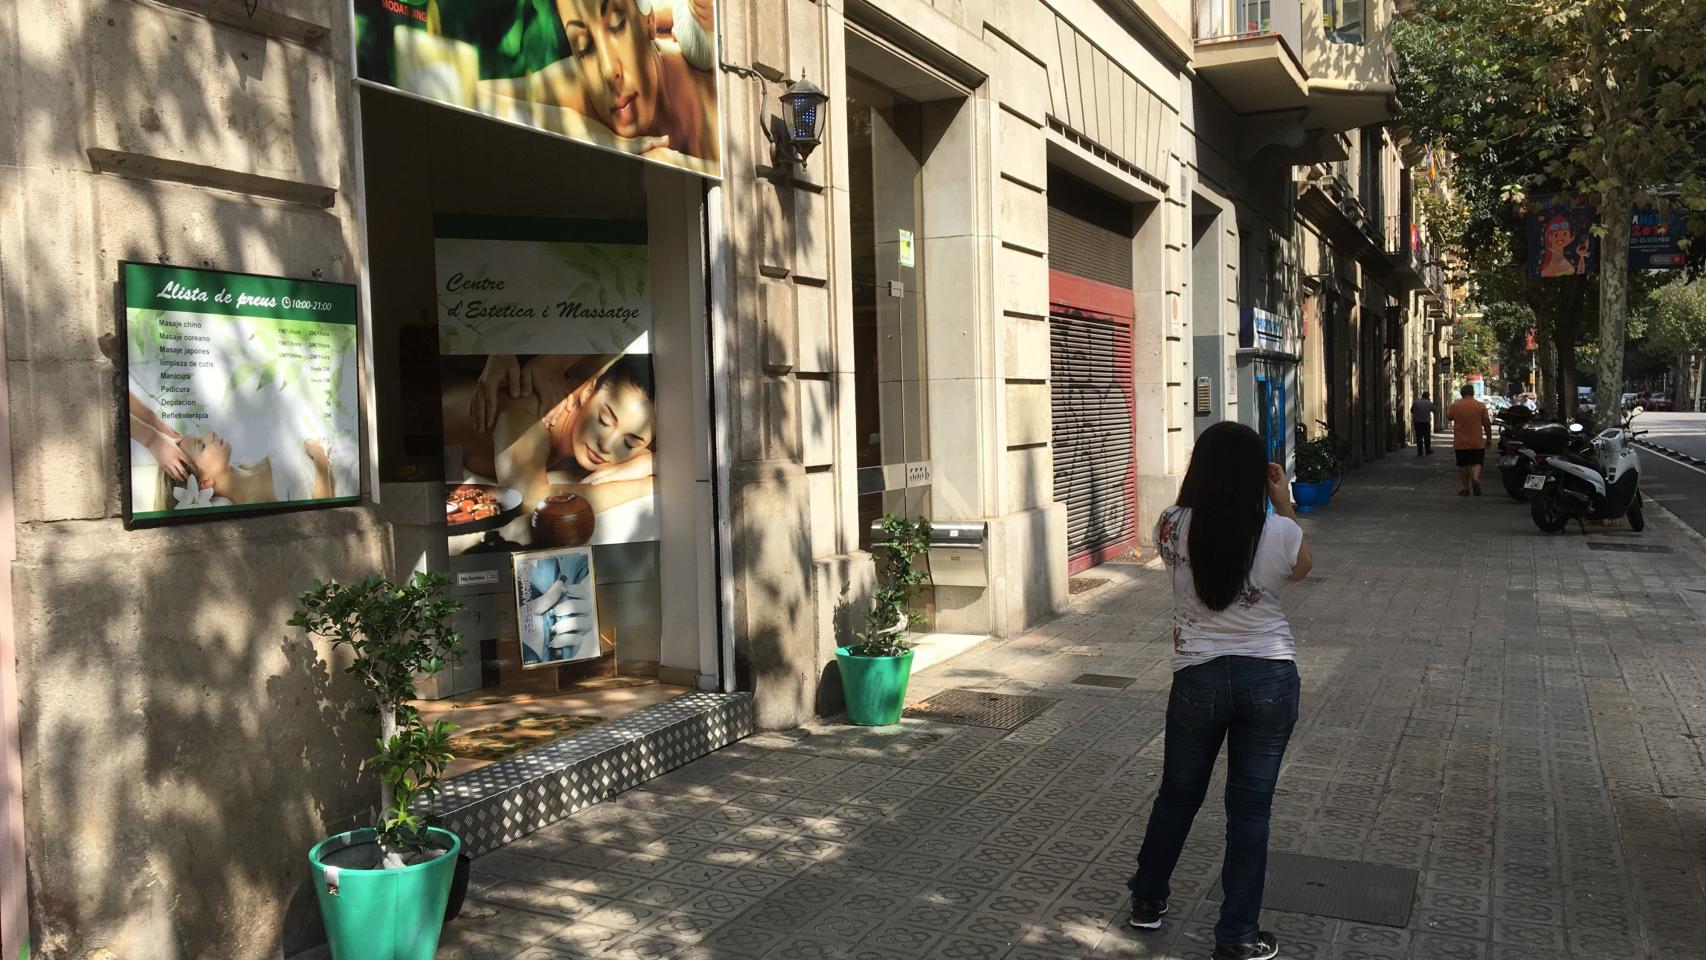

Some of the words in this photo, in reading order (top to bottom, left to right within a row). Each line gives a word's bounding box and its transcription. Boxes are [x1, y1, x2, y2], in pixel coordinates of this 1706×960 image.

[382, 0, 409, 16] MODAS
[446, 272, 505, 292] Centre
[157, 280, 209, 302] Llista
[214, 287, 233, 304] de
[236, 292, 277, 309] preus
[291, 299, 332, 311] 10:00-21:00
[447, 300, 535, 319] d'Estetica
[542, 302, 550, 318] i
[556, 301, 639, 323] Massatge
[159, 319, 182, 329] Masaje
[183, 321, 202, 329] chino
[159, 333, 183, 342] Masaje
[159, 346, 183, 355] Masaje
[188, 360, 197, 368] de
[160, 371, 191, 380] Manicura
[160, 385, 190, 393] Pedicura
